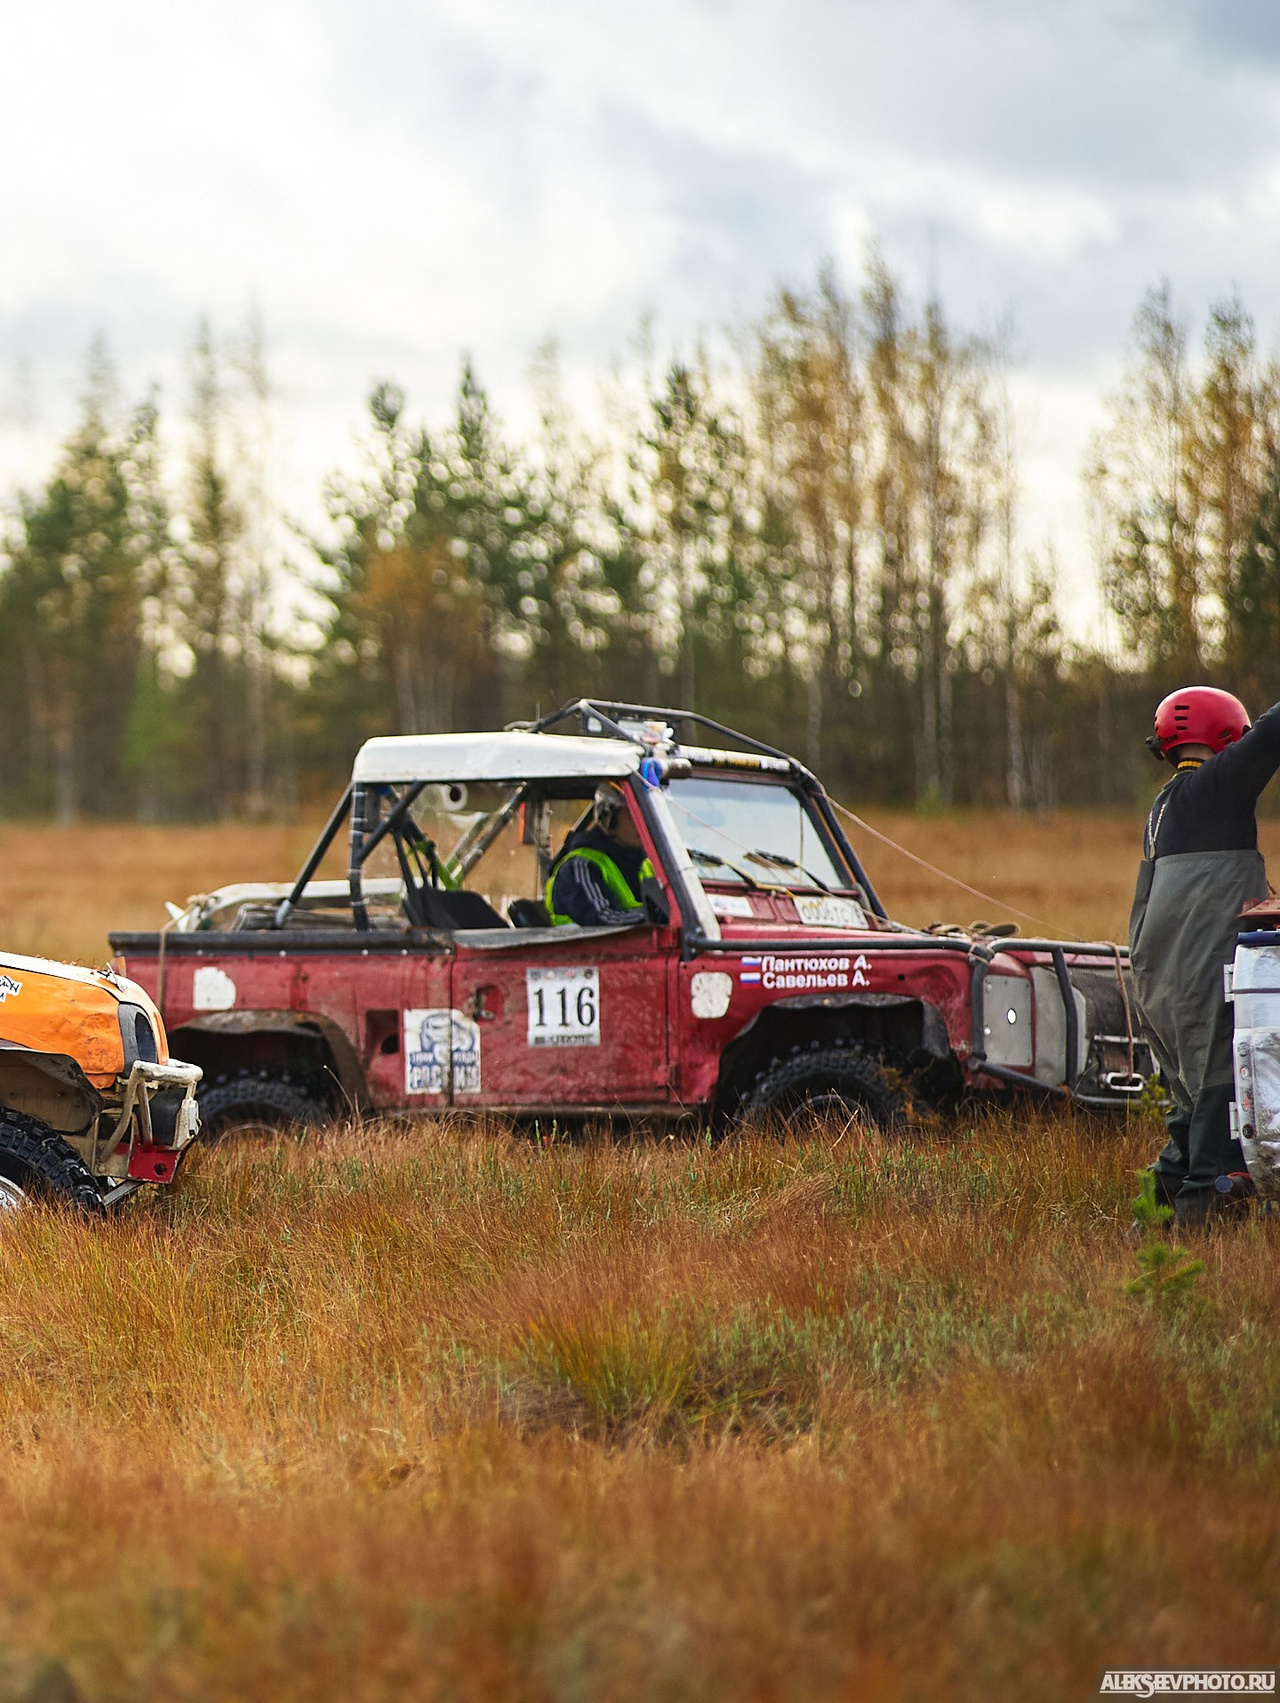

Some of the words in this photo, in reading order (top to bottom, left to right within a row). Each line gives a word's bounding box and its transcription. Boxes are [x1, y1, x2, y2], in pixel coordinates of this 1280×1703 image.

[761, 955, 851, 973] Пантюхов
[853, 954, 873, 971] А.
[762, 971, 849, 990] Савельев
[852, 969, 871, 987] А.
[534, 987, 596, 1027] 116
